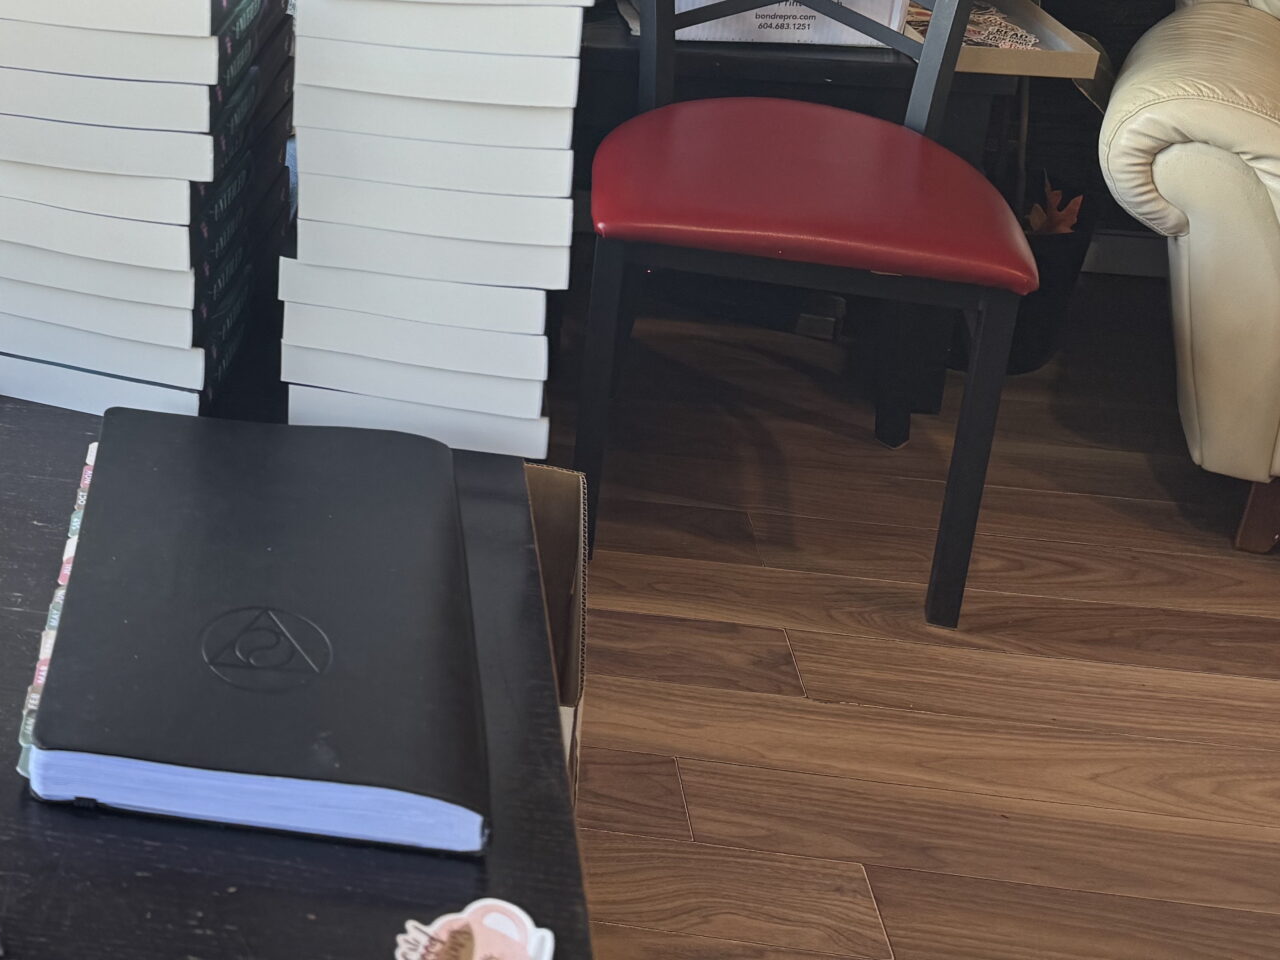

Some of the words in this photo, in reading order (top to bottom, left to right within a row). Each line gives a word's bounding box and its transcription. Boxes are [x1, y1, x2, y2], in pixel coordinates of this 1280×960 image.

[755, 12, 817, 22] bondrepro.com
[757, 23, 811, 31] 604.683.1251
[79, 492, 88, 505] OCT
[49, 608, 60, 626] MAY
[28, 693, 40, 710] FEB
